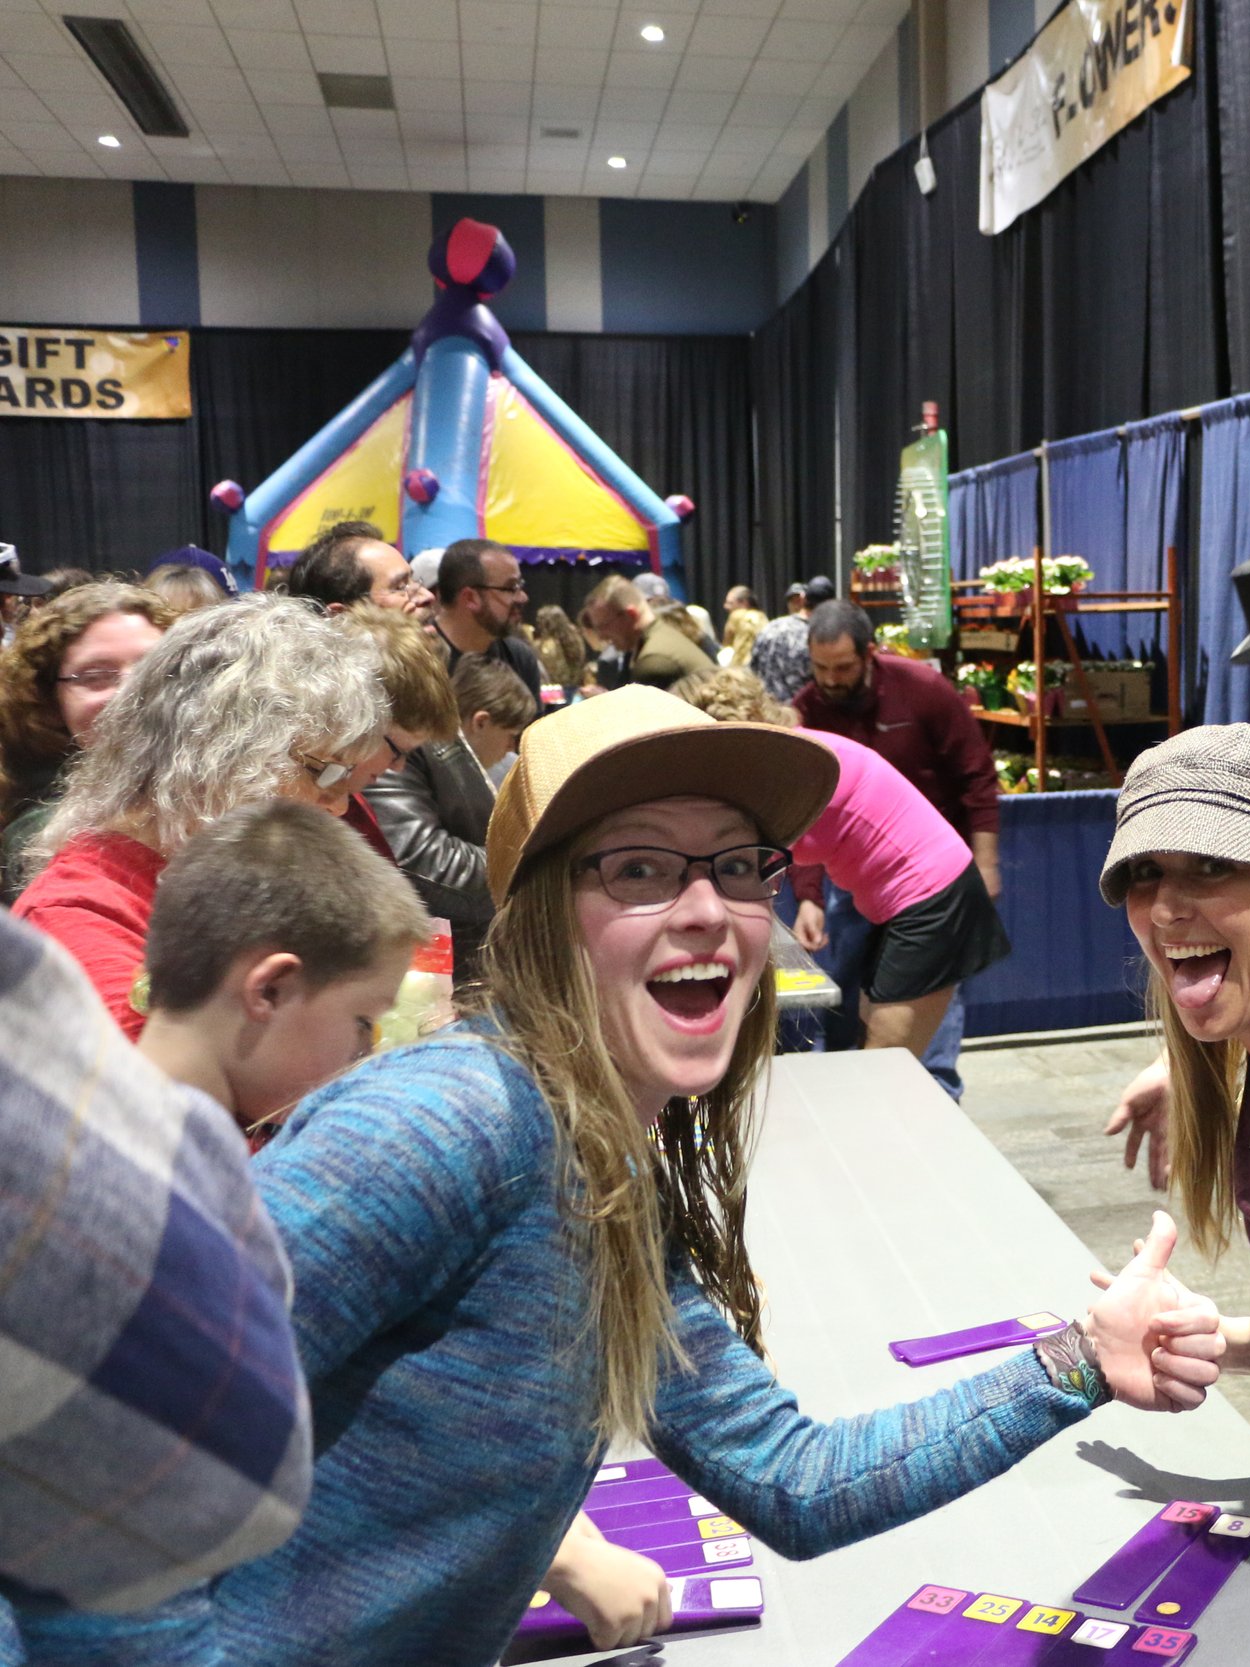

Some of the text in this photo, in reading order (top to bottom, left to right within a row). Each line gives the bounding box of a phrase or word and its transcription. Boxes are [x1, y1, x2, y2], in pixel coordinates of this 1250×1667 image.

[1175, 1507, 1244, 1532] 15 8
[714, 1543, 739, 1557] 38
[919, 1592, 1181, 1650] 33 25 14 17 35
